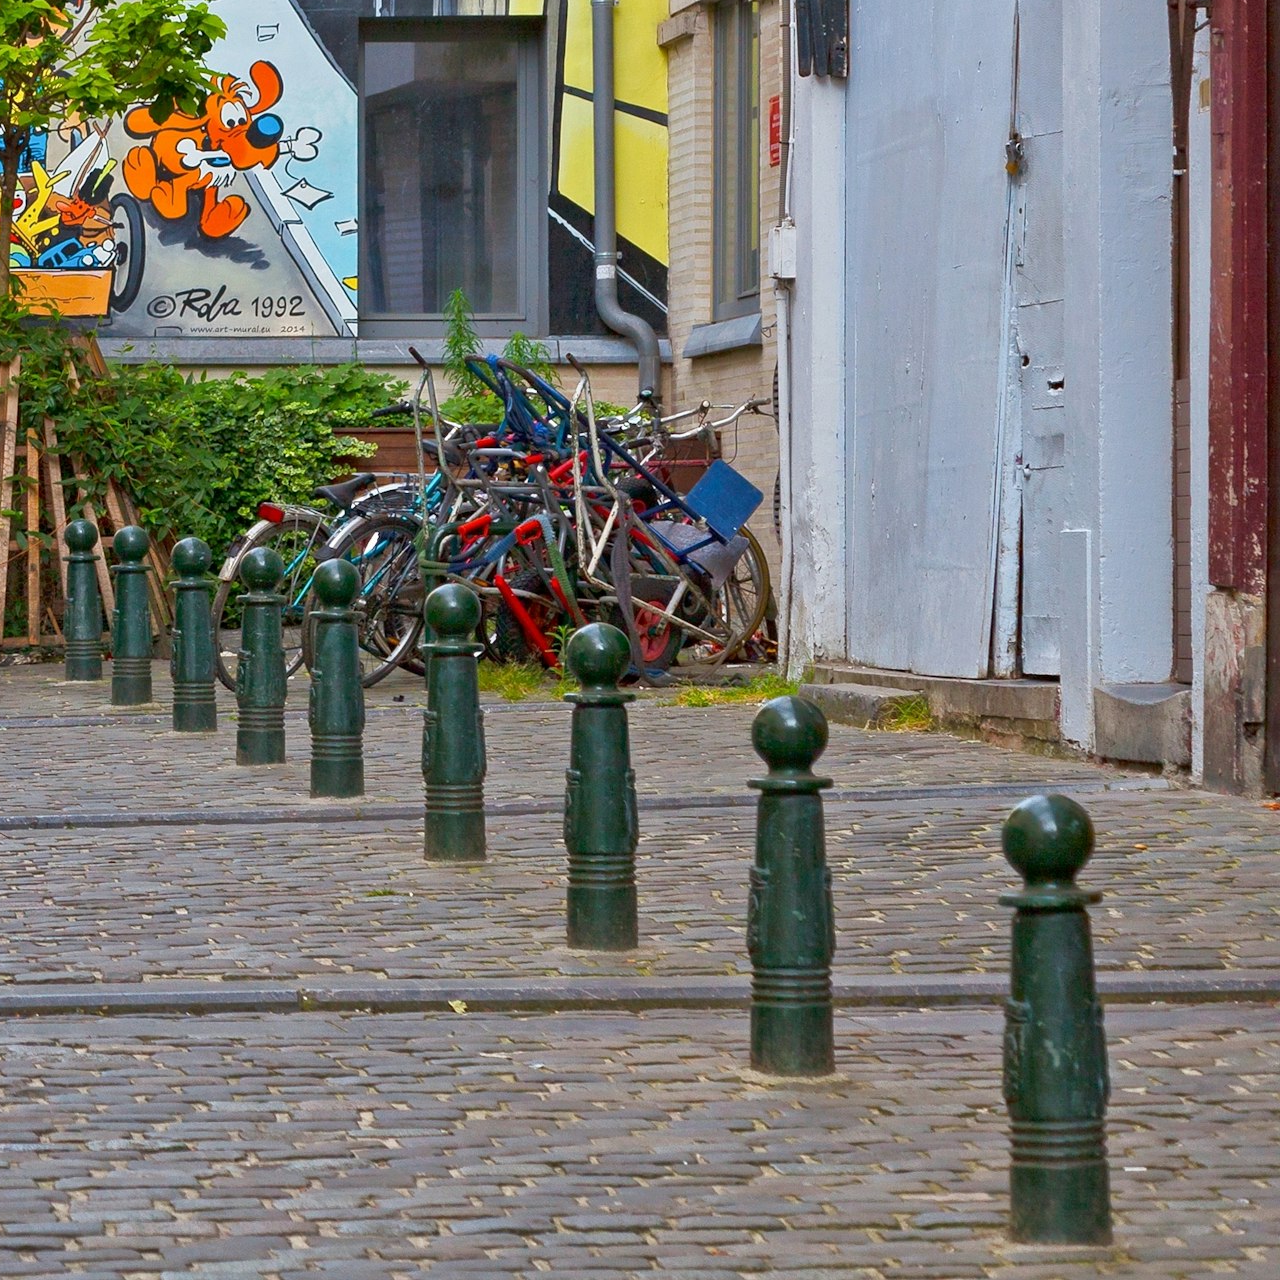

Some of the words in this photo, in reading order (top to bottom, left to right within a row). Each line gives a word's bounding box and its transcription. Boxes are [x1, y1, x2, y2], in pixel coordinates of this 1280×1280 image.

[251, 296, 305, 318] 1992
[190, 325, 271, 334] www.art-mural.eu
[280, 325, 305, 333] 2014
